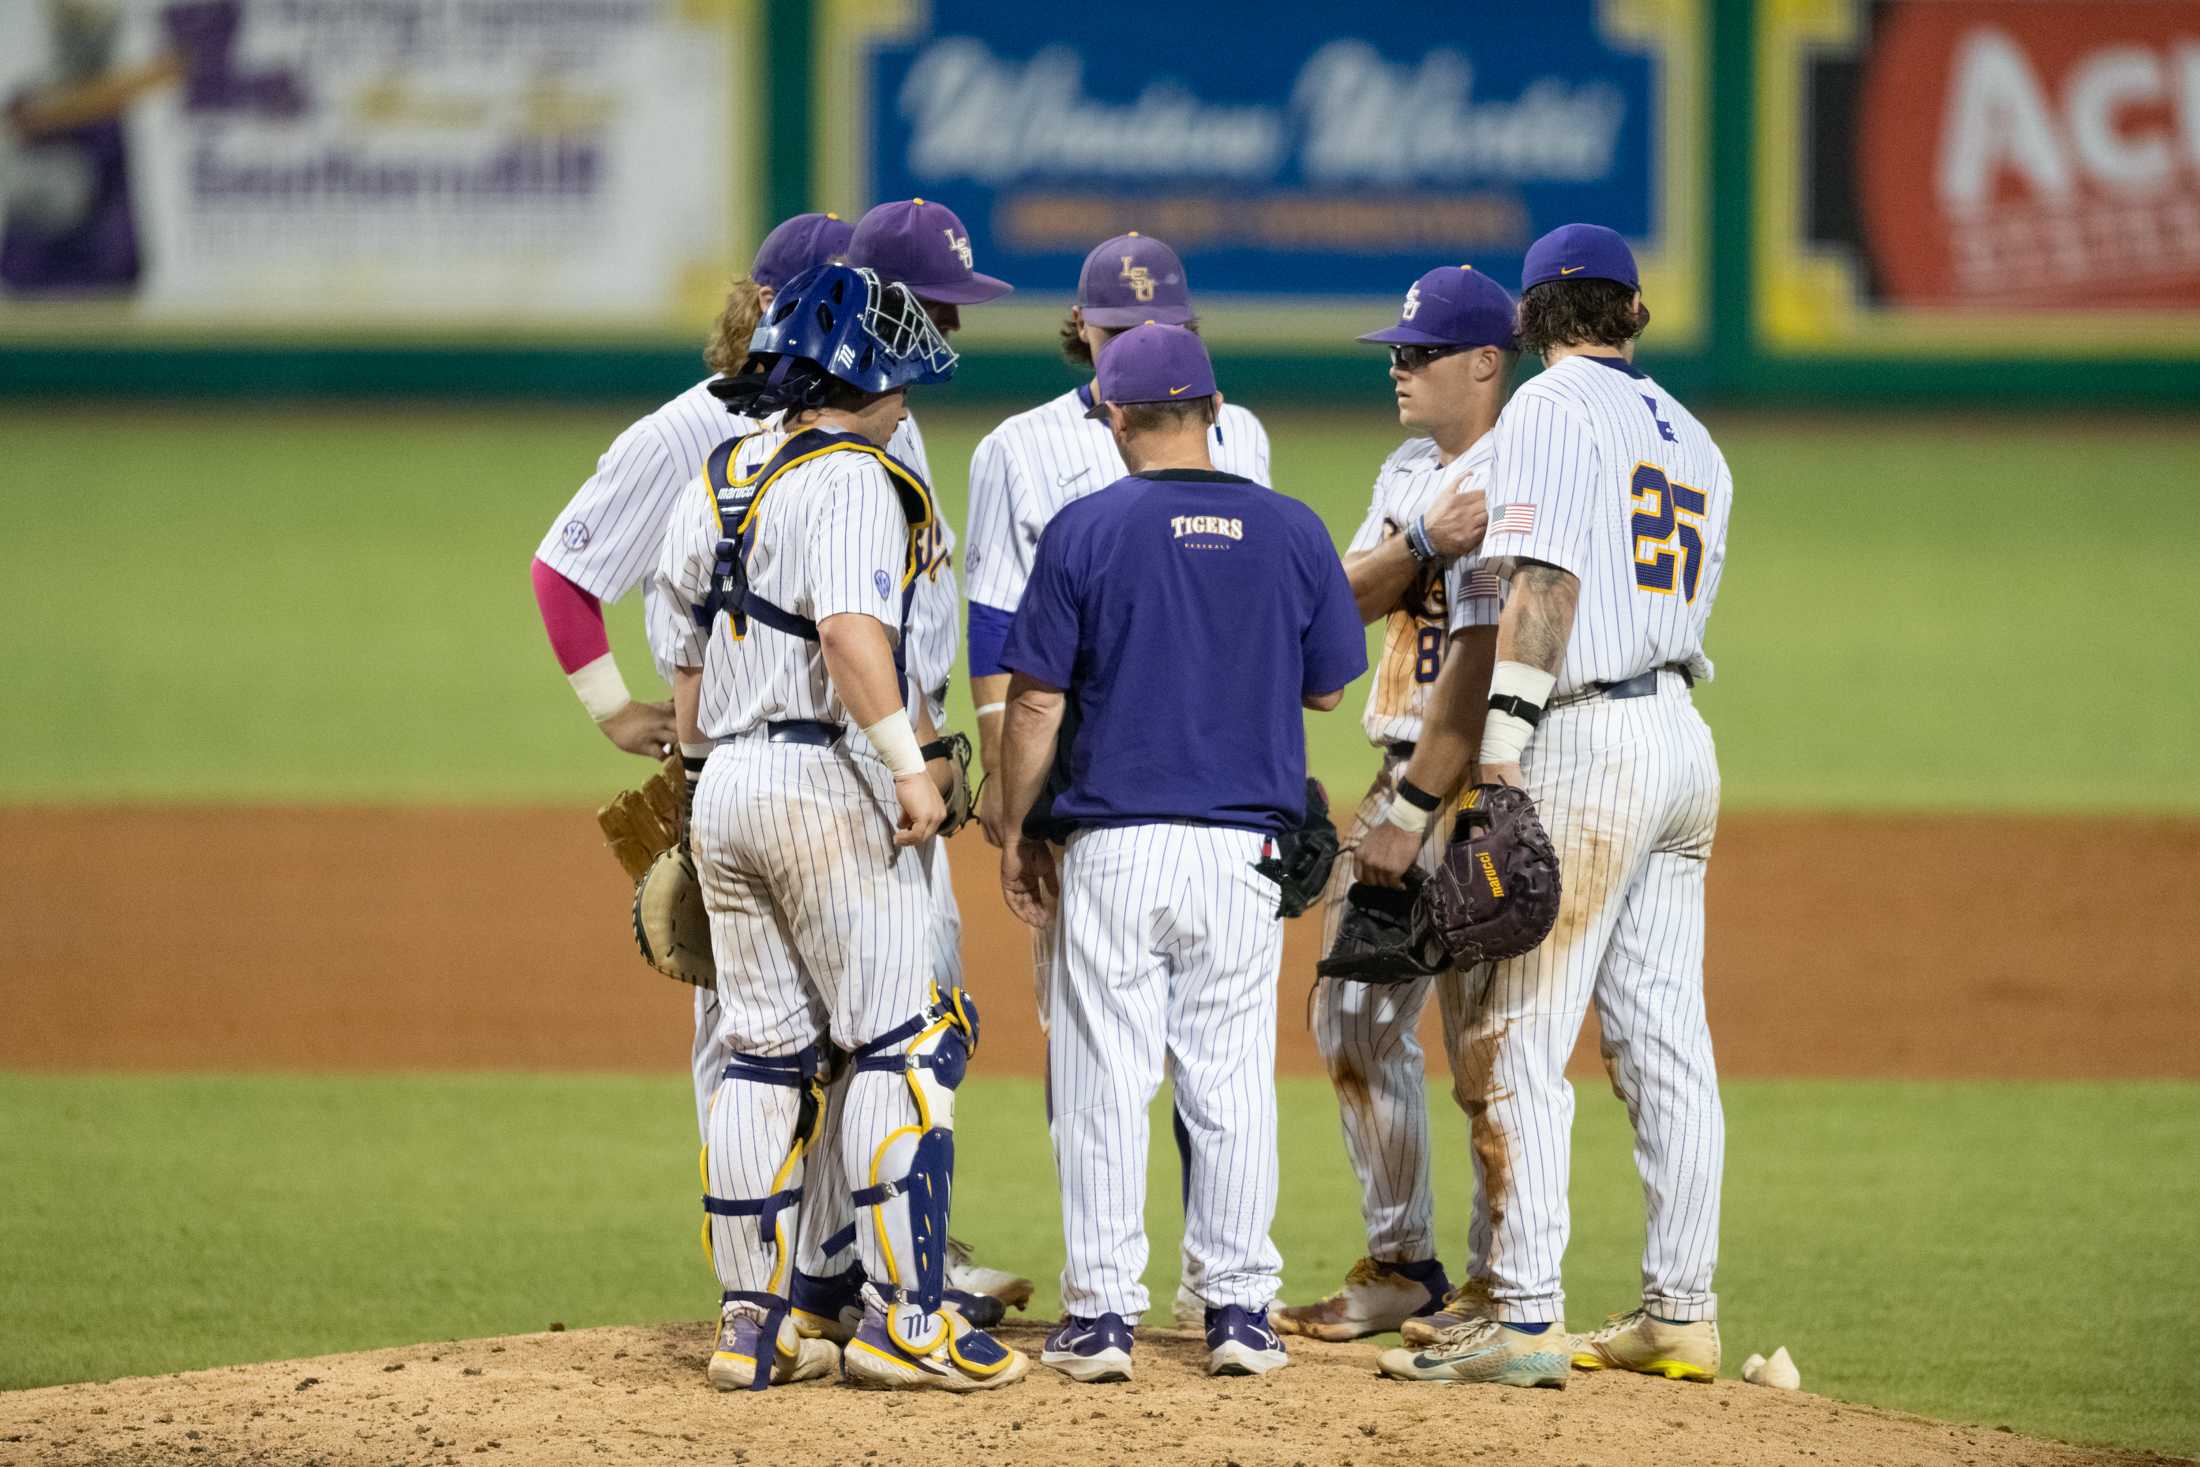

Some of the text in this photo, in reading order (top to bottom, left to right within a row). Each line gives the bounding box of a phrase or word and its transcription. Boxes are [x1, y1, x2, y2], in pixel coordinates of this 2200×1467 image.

[943, 228, 974, 270] LSU
[1119, 255, 1158, 302] LSU
[1170, 515, 1243, 541] TIGERS
[1630, 460, 1709, 608] 25
[1414, 626, 1442, 685] 8
[1474, 851, 1505, 898] marucci
